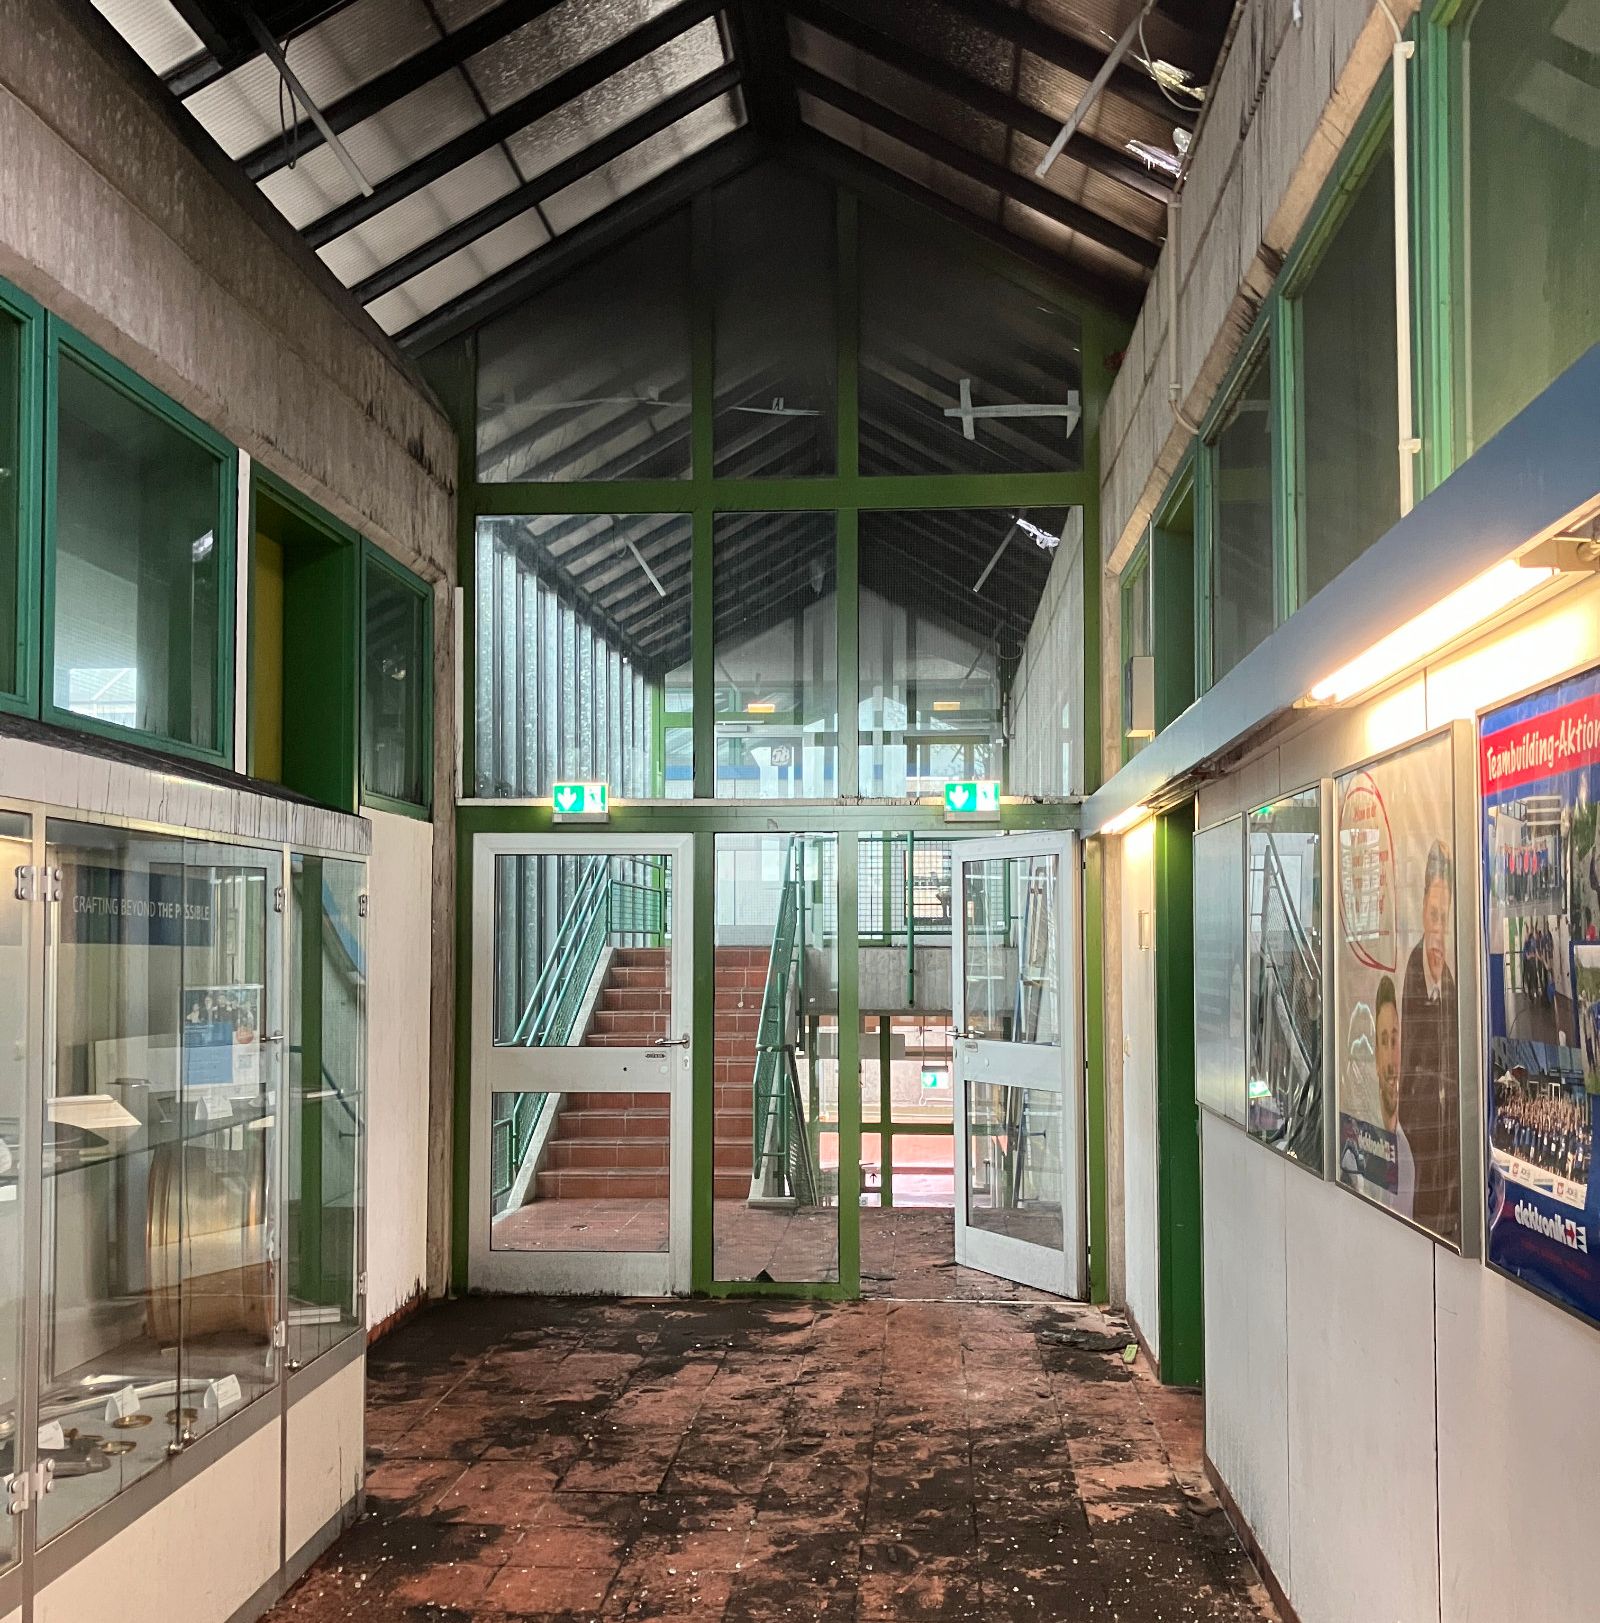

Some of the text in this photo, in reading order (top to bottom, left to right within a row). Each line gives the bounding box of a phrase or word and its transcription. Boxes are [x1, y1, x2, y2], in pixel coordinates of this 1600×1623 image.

[73, 895, 209, 920] CRAFTING BEYOND THE PSSIBLE
